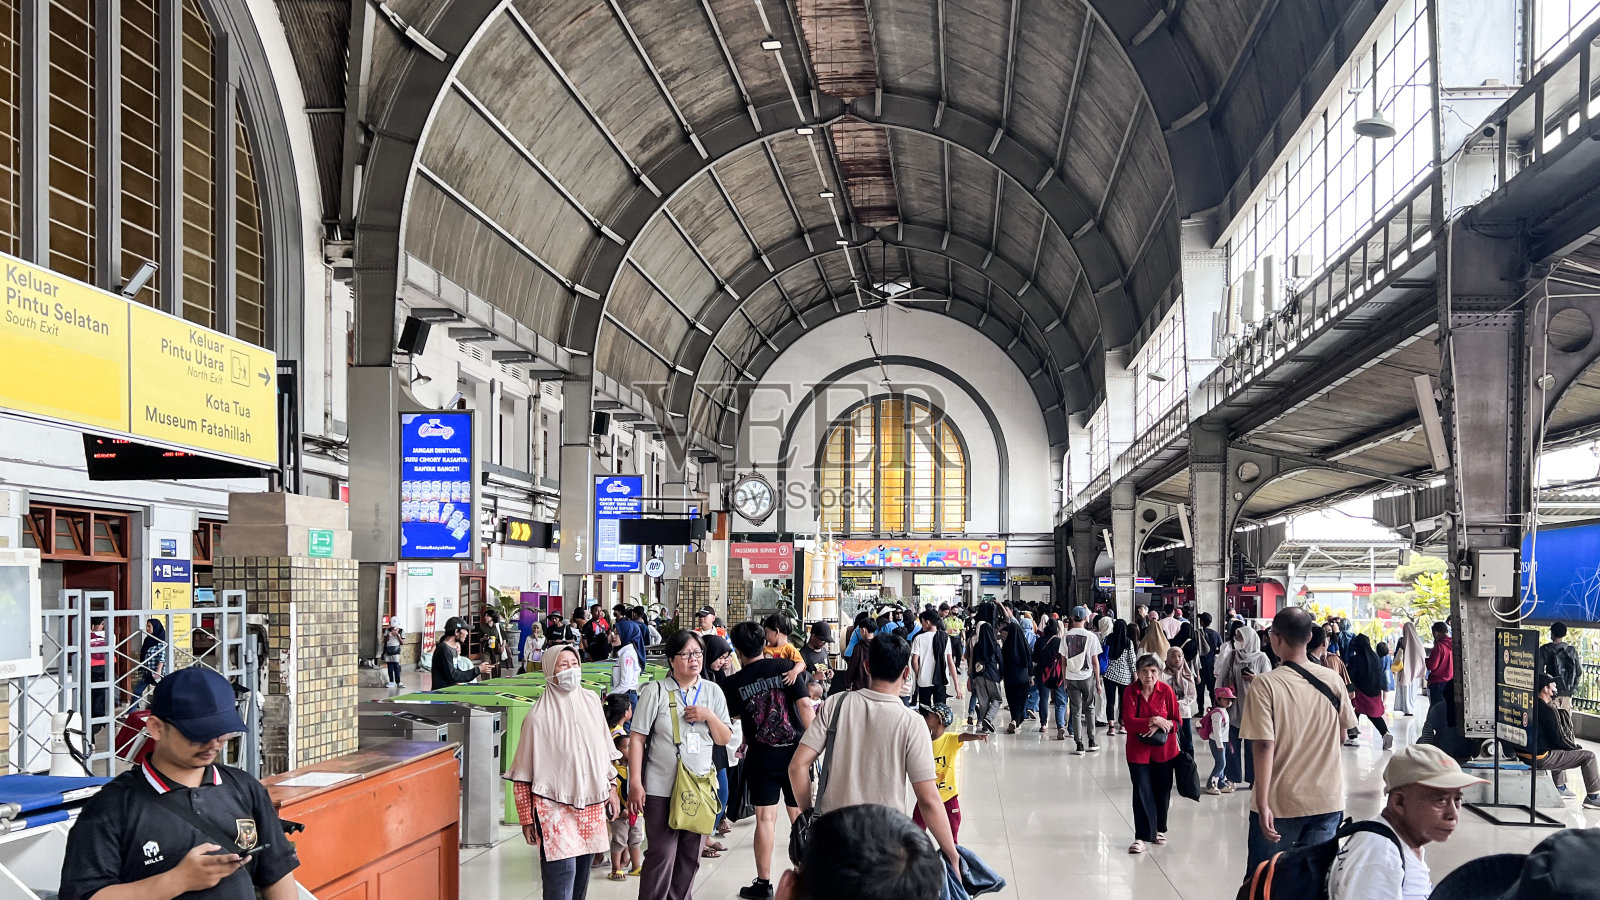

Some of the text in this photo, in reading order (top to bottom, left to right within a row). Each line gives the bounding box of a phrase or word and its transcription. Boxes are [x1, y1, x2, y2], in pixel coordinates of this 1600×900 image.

[6, 263, 59, 298] Keluar
[5, 310, 59, 337] South Exit
[6, 286, 109, 336] Pintu Selatan
[189, 328, 225, 354] Keluar
[161, 338, 225, 372] Pintu Utara
[187, 365, 223, 385] North Exit
[205, 393, 251, 419] Kota Tua
[145, 405, 252, 444] Museum Fatahillah
[1519, 633, 1523, 646] 7
[144, 857, 164, 866] MILLS
